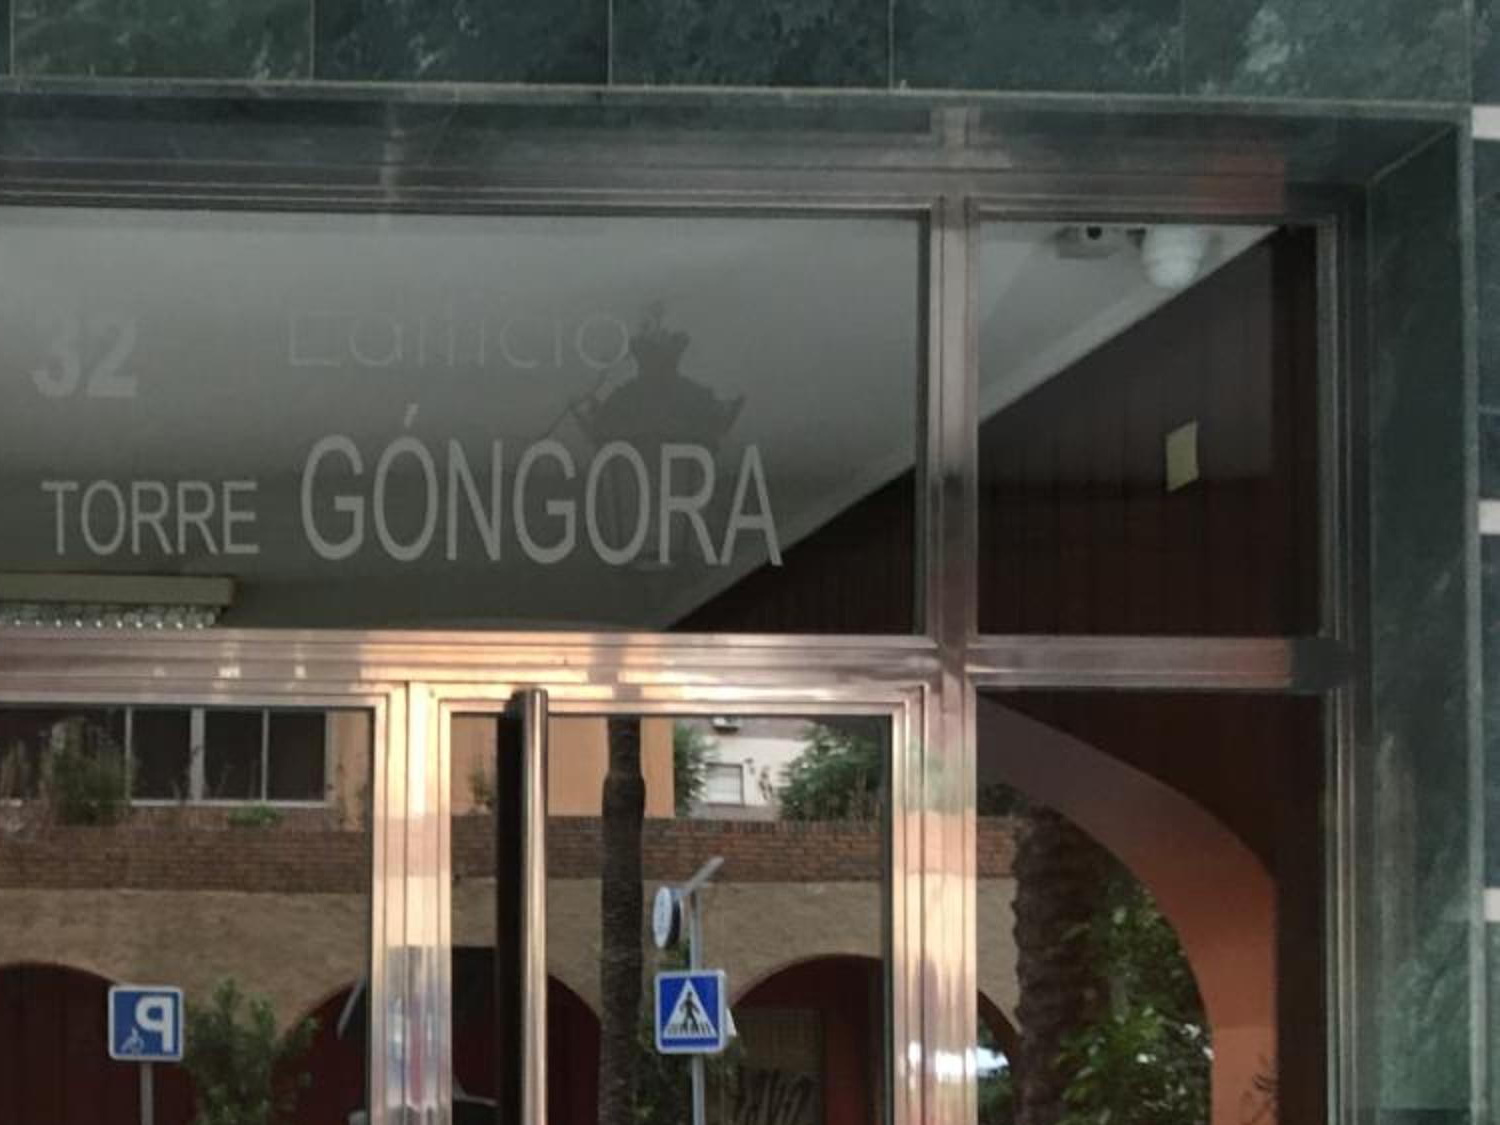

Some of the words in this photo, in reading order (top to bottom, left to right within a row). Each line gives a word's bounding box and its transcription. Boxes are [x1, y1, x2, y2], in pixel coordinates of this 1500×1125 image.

[30, 308, 139, 398] 32
[41, 480, 260, 557] TORRE
[300, 402, 784, 568] GÓNGORA
